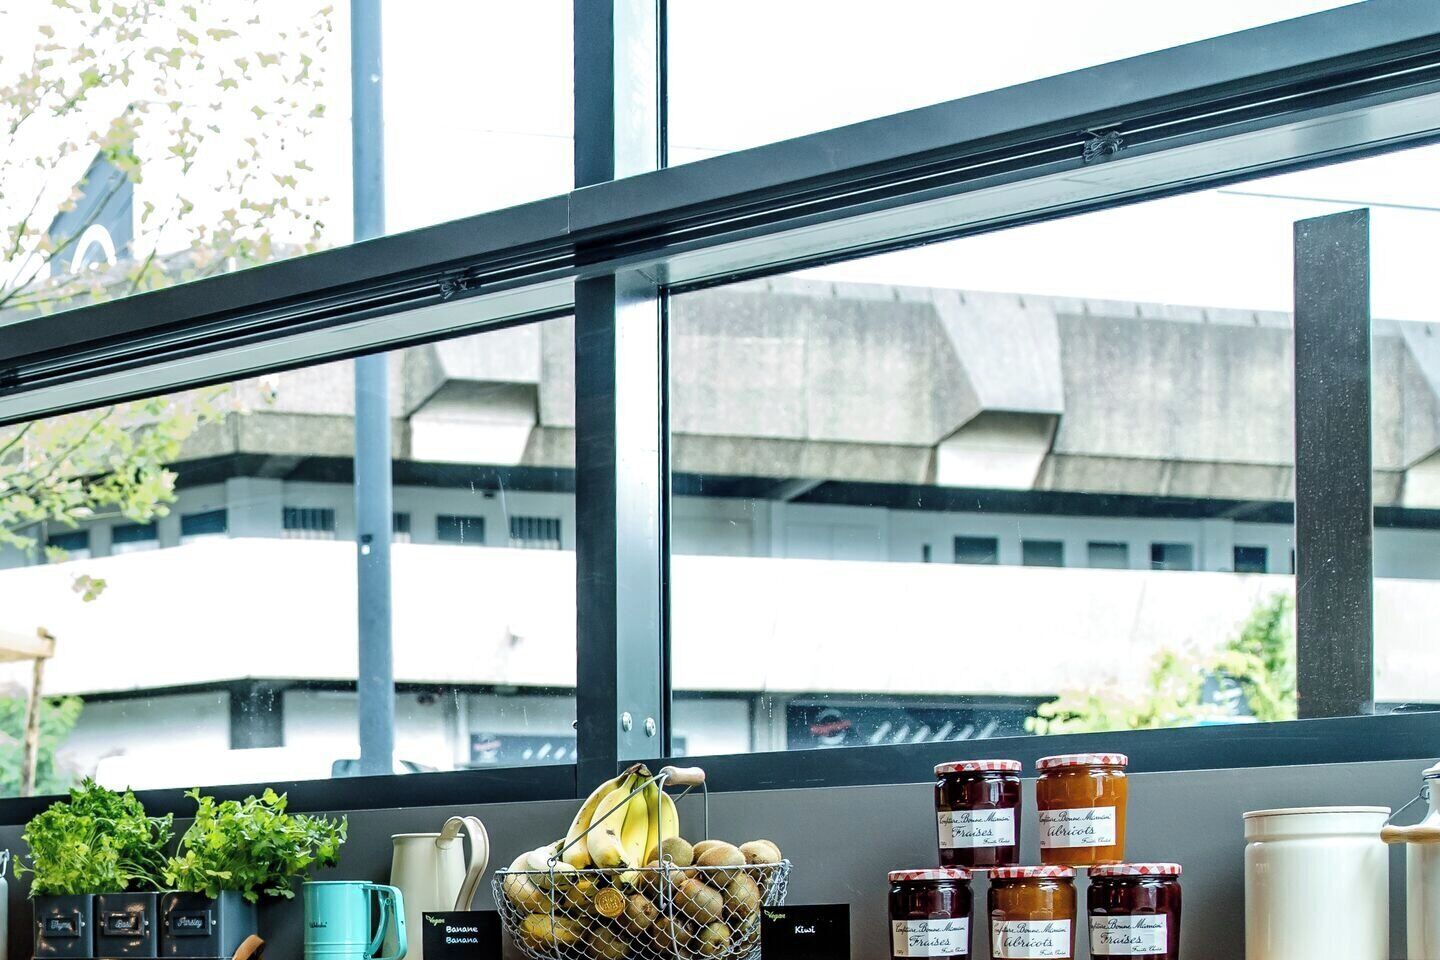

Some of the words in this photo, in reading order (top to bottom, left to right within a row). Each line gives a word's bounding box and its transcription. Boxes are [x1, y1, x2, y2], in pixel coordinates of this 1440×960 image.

[951, 825, 994, 838] Fraises
[445, 925, 478, 933] Banane
[794, 925, 816, 934] Kiwi
[445, 936, 478, 944] Banana
[909, 935, 951, 947] Fraises
[1100, 931, 1143, 944] Fraises
